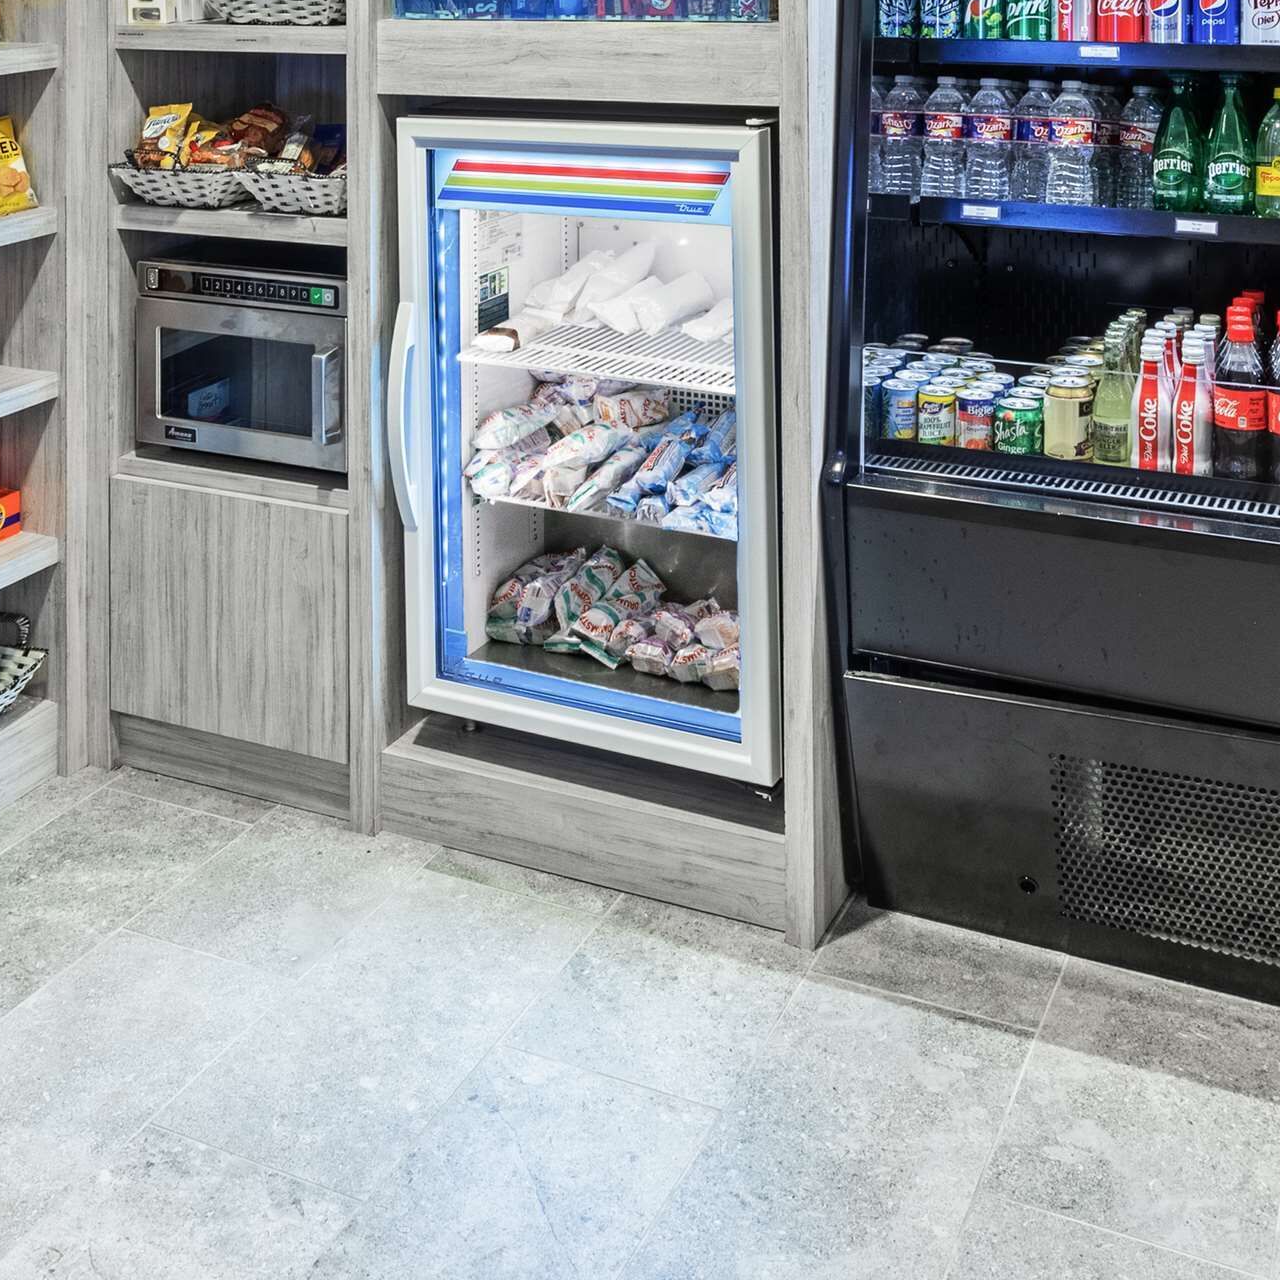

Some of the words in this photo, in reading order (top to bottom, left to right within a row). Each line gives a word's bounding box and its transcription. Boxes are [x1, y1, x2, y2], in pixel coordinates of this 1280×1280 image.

[1257, 15, 1276, 26] Diet
[1260, 172, 1280, 183] Topo
[1140, 400, 1157, 442] Coke
[1177, 401, 1194, 443] Coke
[994, 421, 1029, 443] Shasta
[998, 442, 1026, 455] Ginger
